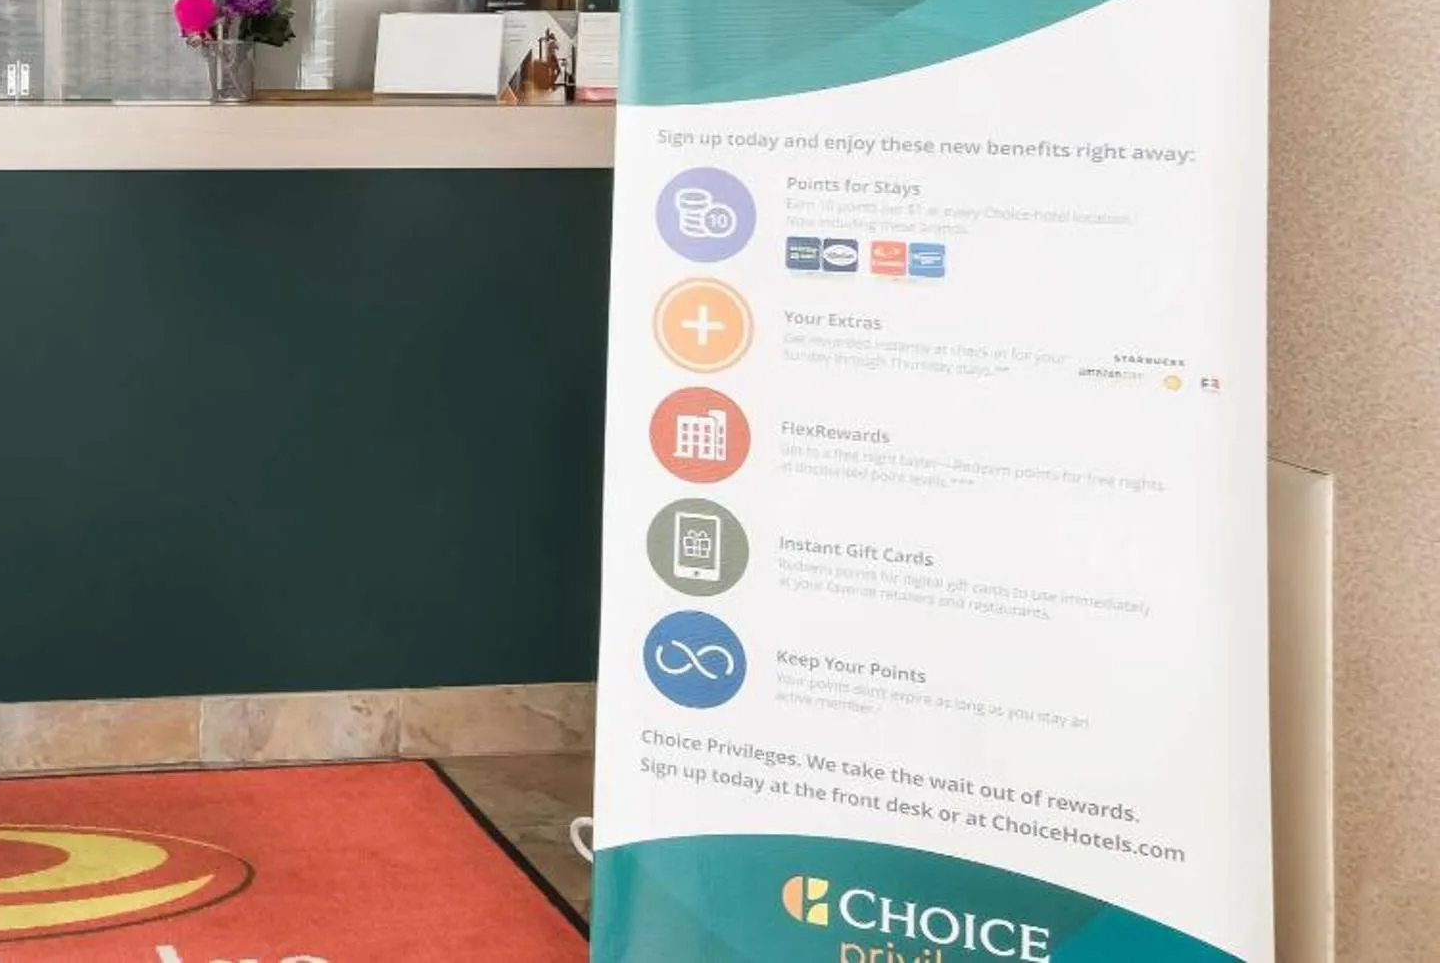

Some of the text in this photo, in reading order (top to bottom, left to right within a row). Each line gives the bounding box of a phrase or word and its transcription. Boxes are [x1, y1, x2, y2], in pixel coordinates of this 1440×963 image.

[657, 129, 1197, 167] Sign up today and enjoy these new benefits right away:
[786, 176, 922, 200] Points for Stays
[784, 310, 883, 331] Your Extras
[781, 420, 891, 445] FlexRewards
[779, 535, 936, 567] Instant Gift Cards
[777, 650, 927, 684] Keep Your Points
[641, 729, 1141, 824] Choice Privileges. We take the wait out of rewards.
[640, 757, 1187, 864] Sign up today at the front desk or at ChoiceHotels.com
[838, 888, 1053, 963] CHOICE
